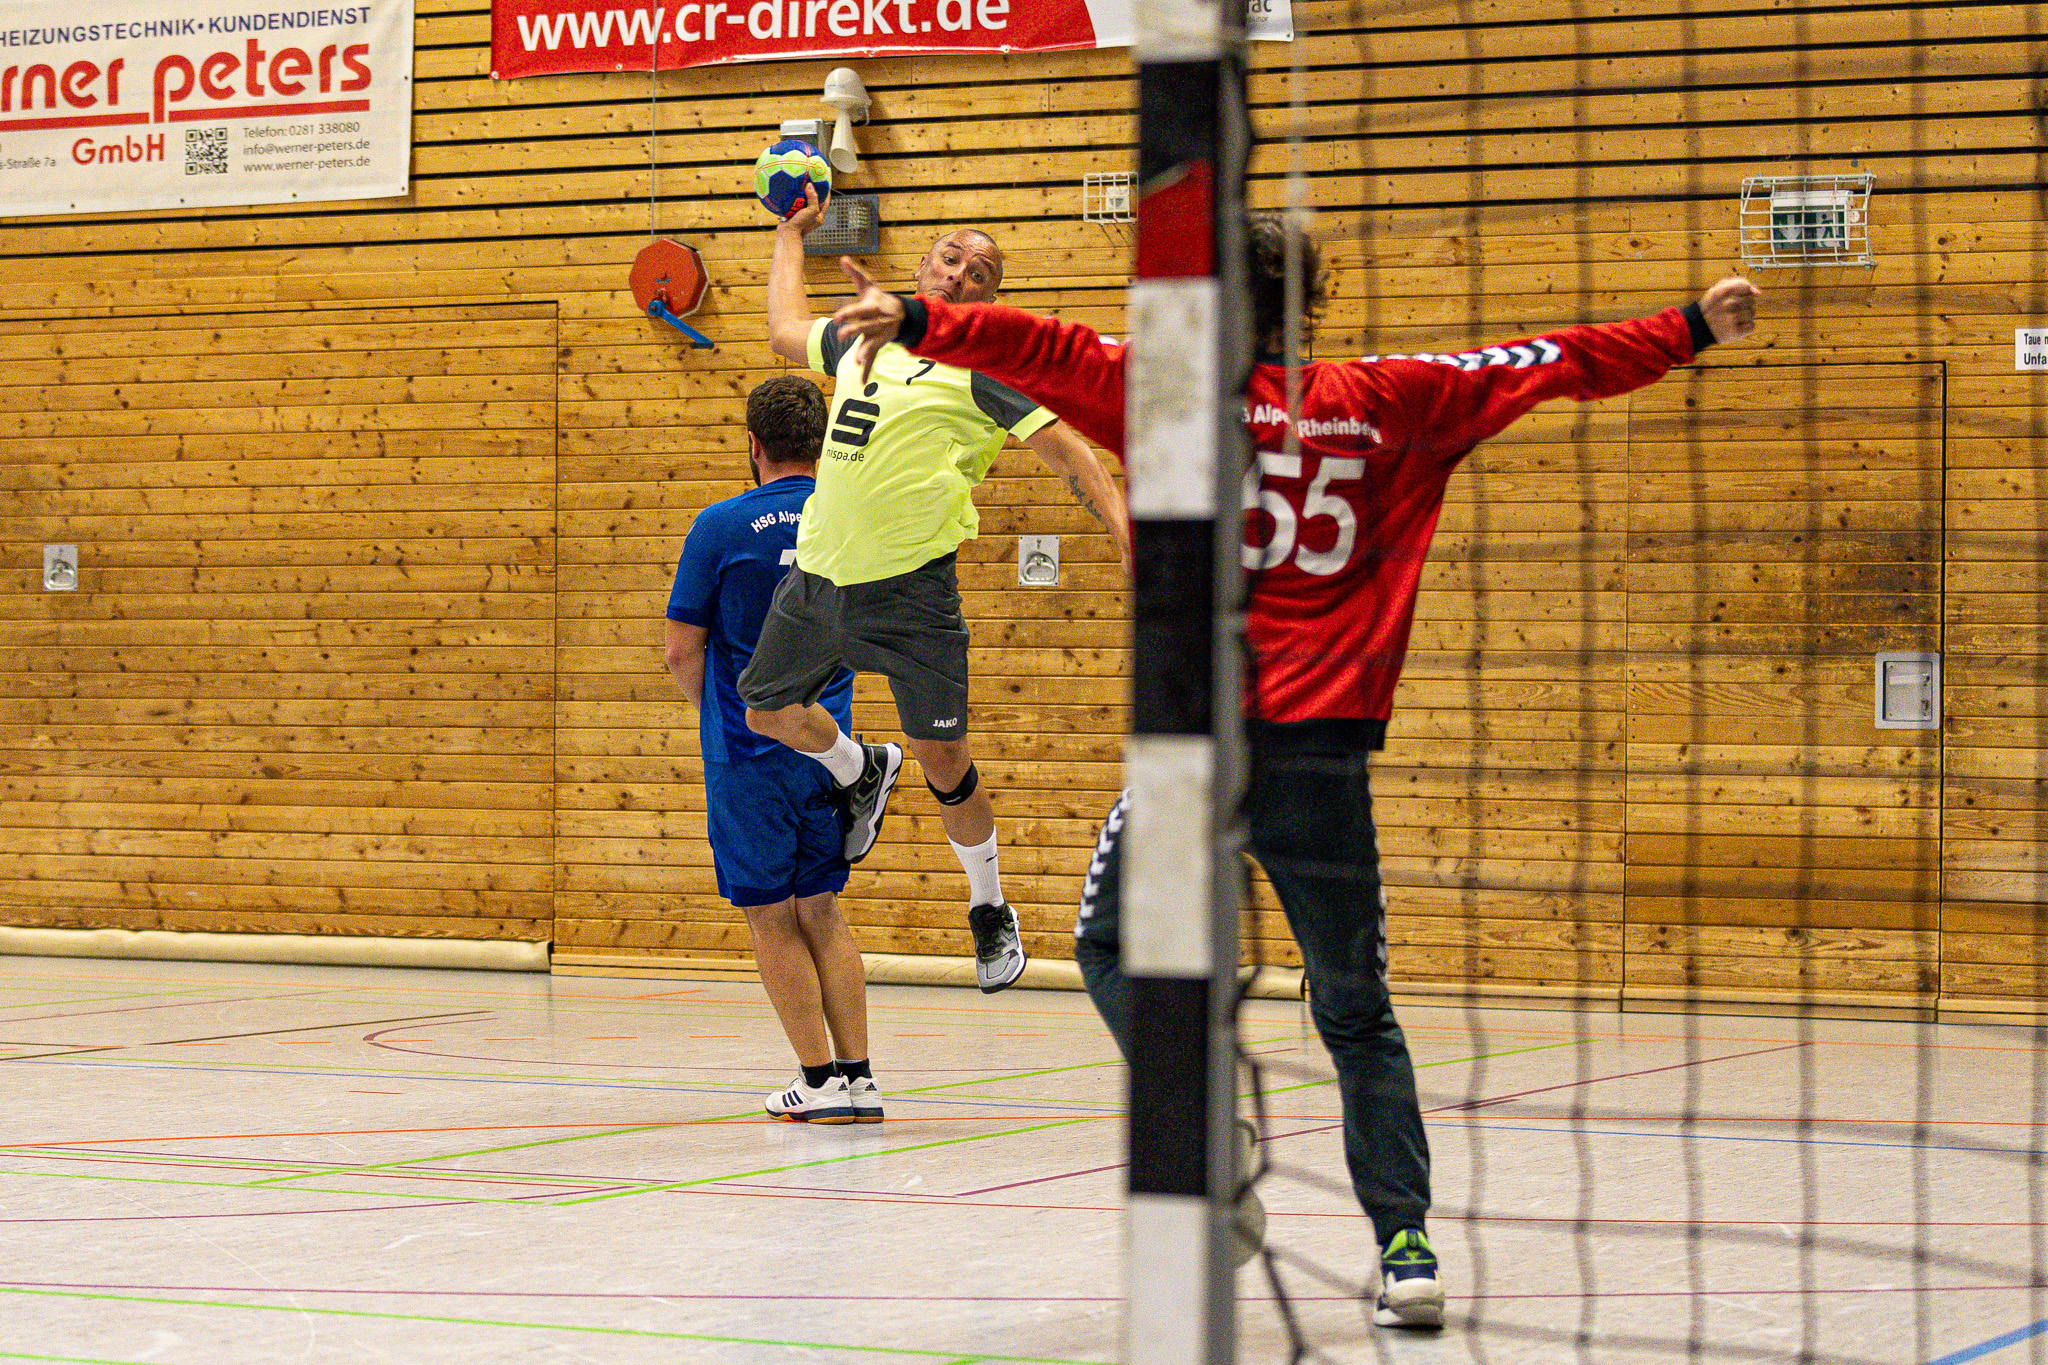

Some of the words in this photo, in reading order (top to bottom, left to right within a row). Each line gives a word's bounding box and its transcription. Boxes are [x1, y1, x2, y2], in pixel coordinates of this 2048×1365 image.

[516, 0, 1010, 51] www.cr-direkt.de
[153, 38, 372, 124] peters
[243, 125, 288, 139] Telefon:
[288, 124, 314, 137] 0281
[318, 121, 361, 135] 338080
[71, 133, 165, 165] GmbH
[243, 138, 370, 155] info@werner-peters.de
[243, 156, 371, 173] www.werner-peters.de
[2024, 333, 2041, 345] Taue
[750, 513, 777, 533] HSG
[1241, 451, 1367, 577] 55
[932, 717, 958, 728] JAKO
